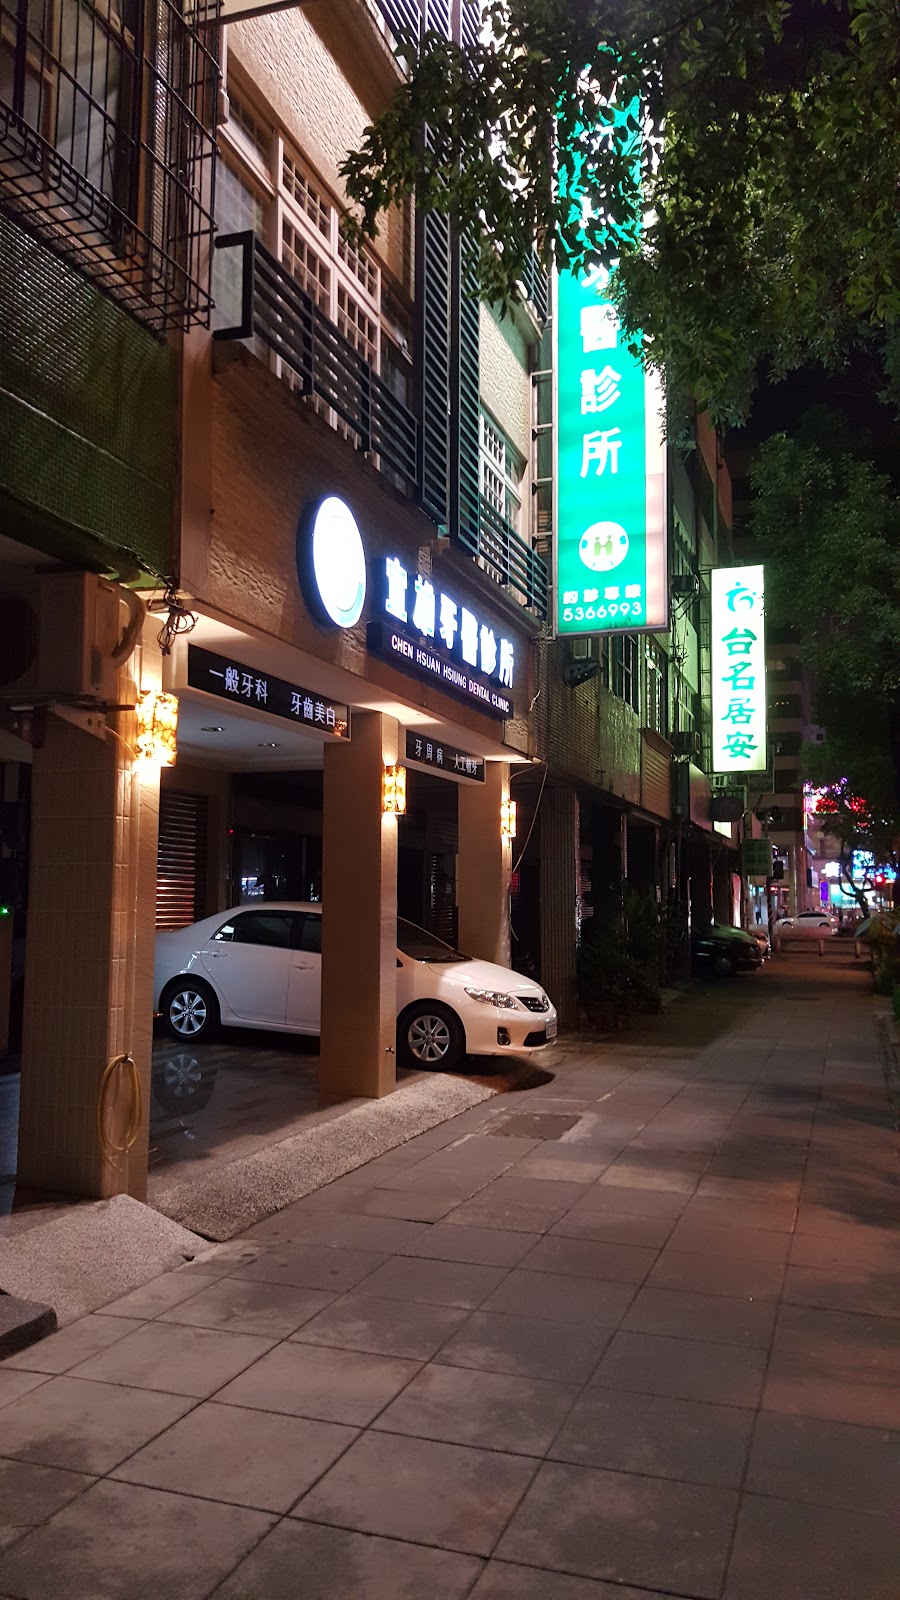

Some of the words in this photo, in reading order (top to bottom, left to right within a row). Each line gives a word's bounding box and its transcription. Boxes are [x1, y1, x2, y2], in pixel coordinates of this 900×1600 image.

[562, 601, 643, 622] 5366993
[209, 666, 269, 704] 一般牙科
[290, 691, 336, 728] 牙齒美白
[391, 634, 414, 659] CHEN
[416, 648, 441, 675] HSUAN
[443, 664, 467, 689] HSIUNG
[469, 679, 491, 703] DENTAL
[491, 692, 510, 713] CLINIC
[720, 627, 758, 759] 台名居安
[414, 738, 444, 765] 牙周病
[453, 753, 478, 776] 人工植牙
